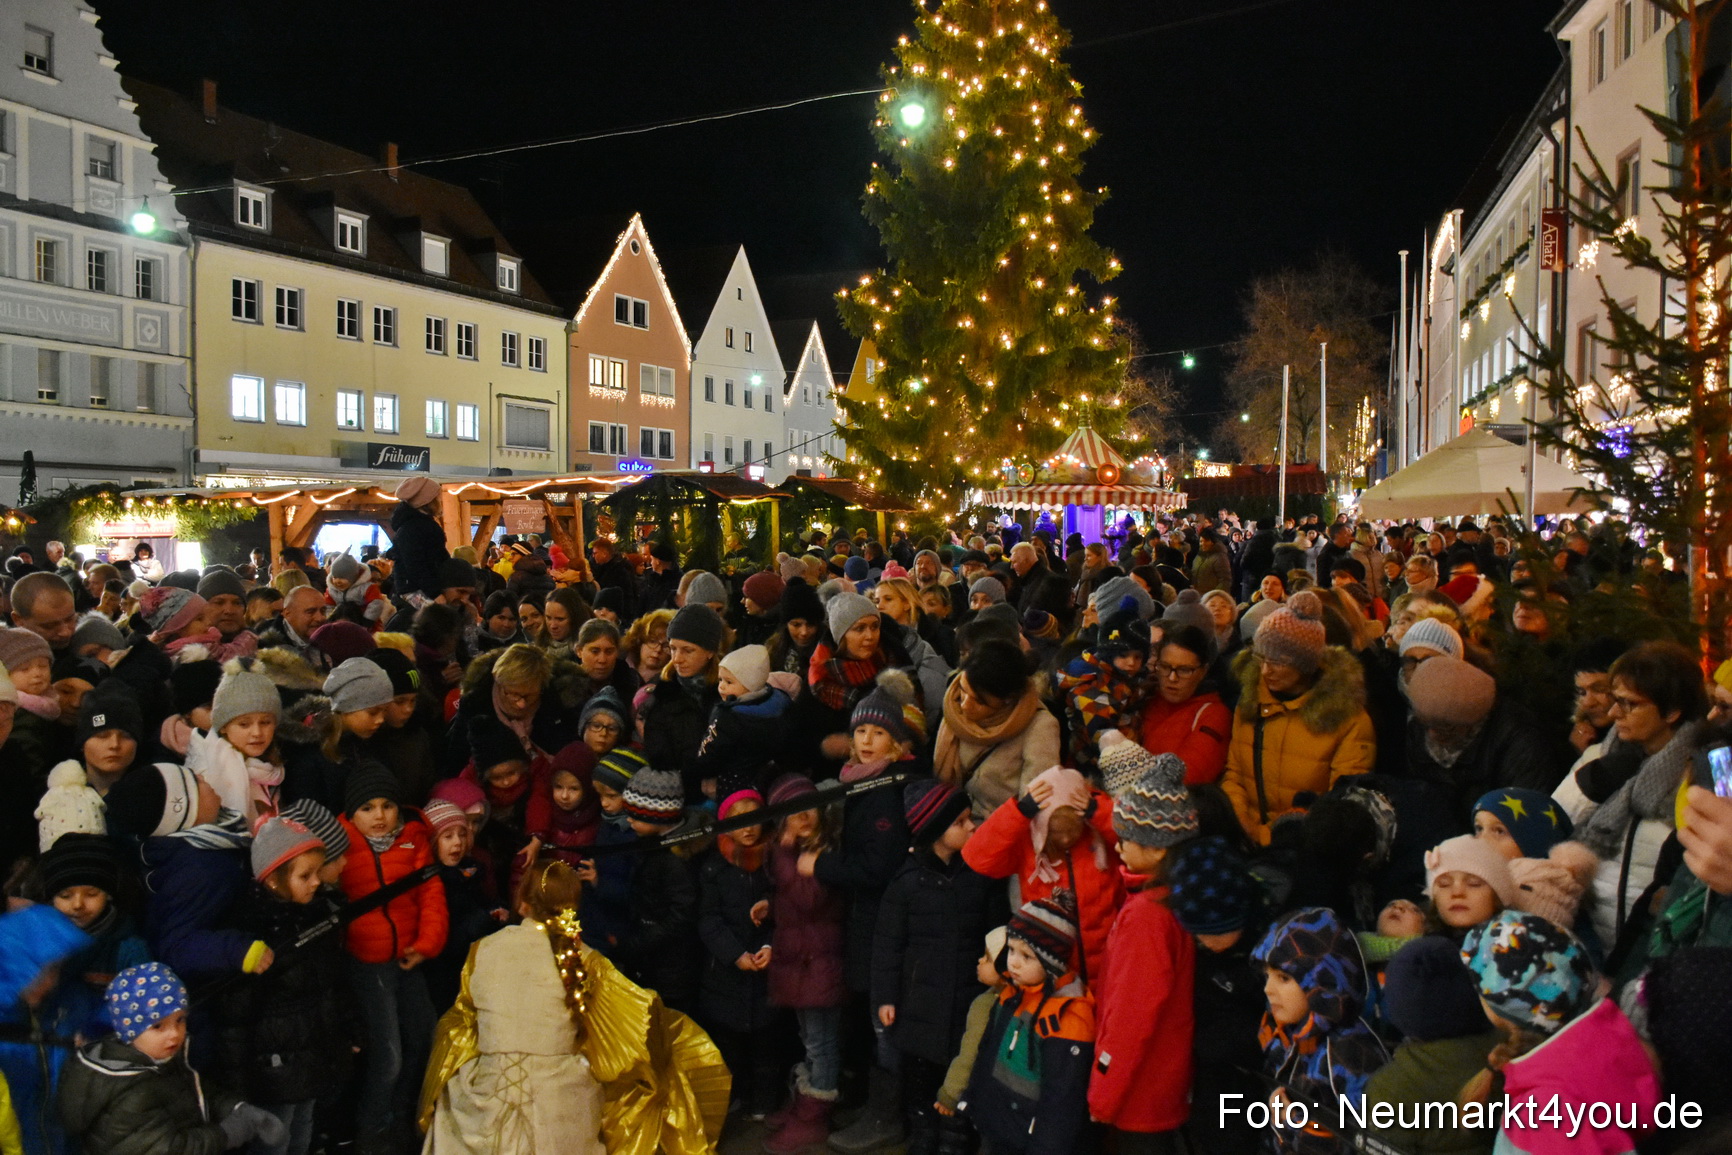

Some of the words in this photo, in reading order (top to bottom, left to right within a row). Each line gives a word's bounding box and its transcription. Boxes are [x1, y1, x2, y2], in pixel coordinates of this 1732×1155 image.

[1543, 222, 1558, 266] Achatz
[52, 307, 111, 333] WEBER
[372, 446, 428, 468] frühauf
